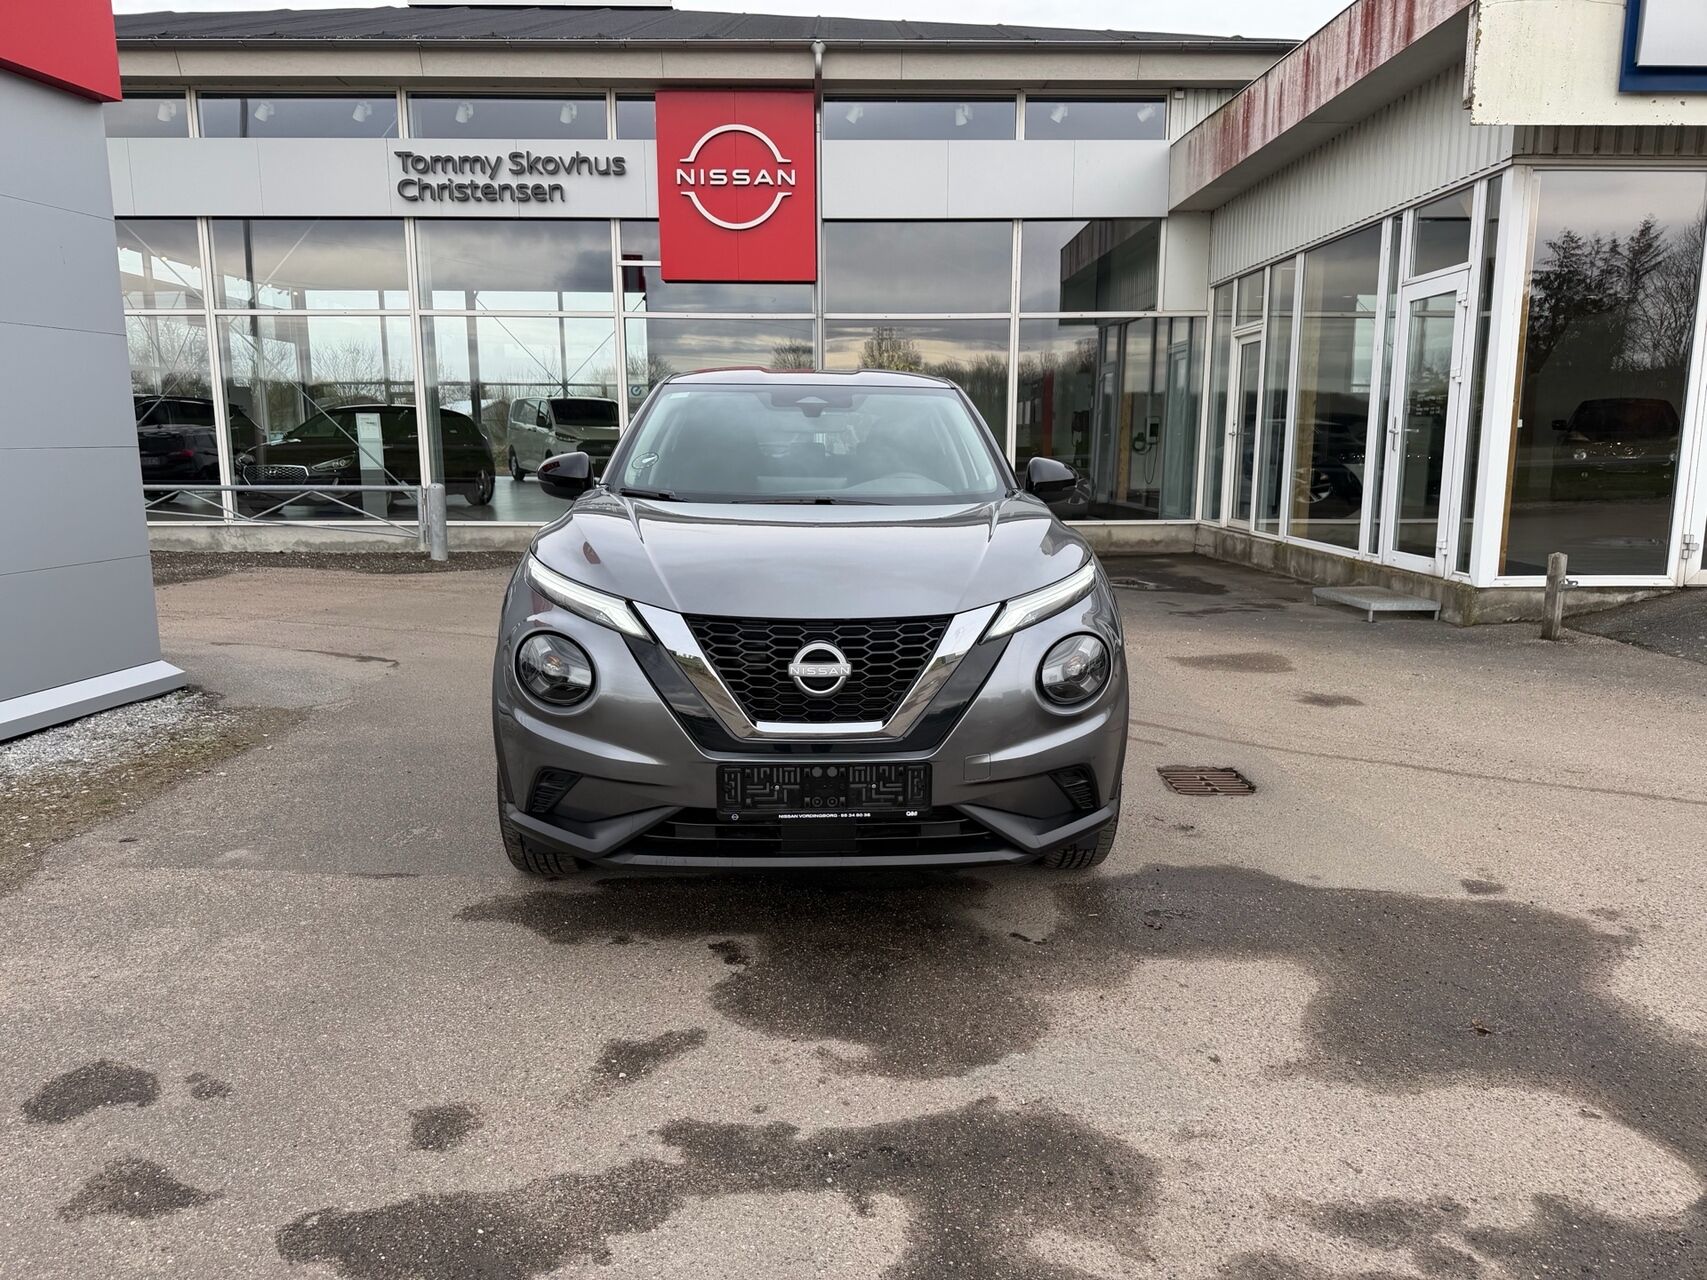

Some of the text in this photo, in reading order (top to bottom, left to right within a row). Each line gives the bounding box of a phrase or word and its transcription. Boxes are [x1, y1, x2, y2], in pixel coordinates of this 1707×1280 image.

[394, 150, 626, 179] Tommy Skovhus
[676, 168, 796, 186] NISSAN
[397, 177, 566, 203] Christensen
[790, 667, 850, 675] NISSAN
